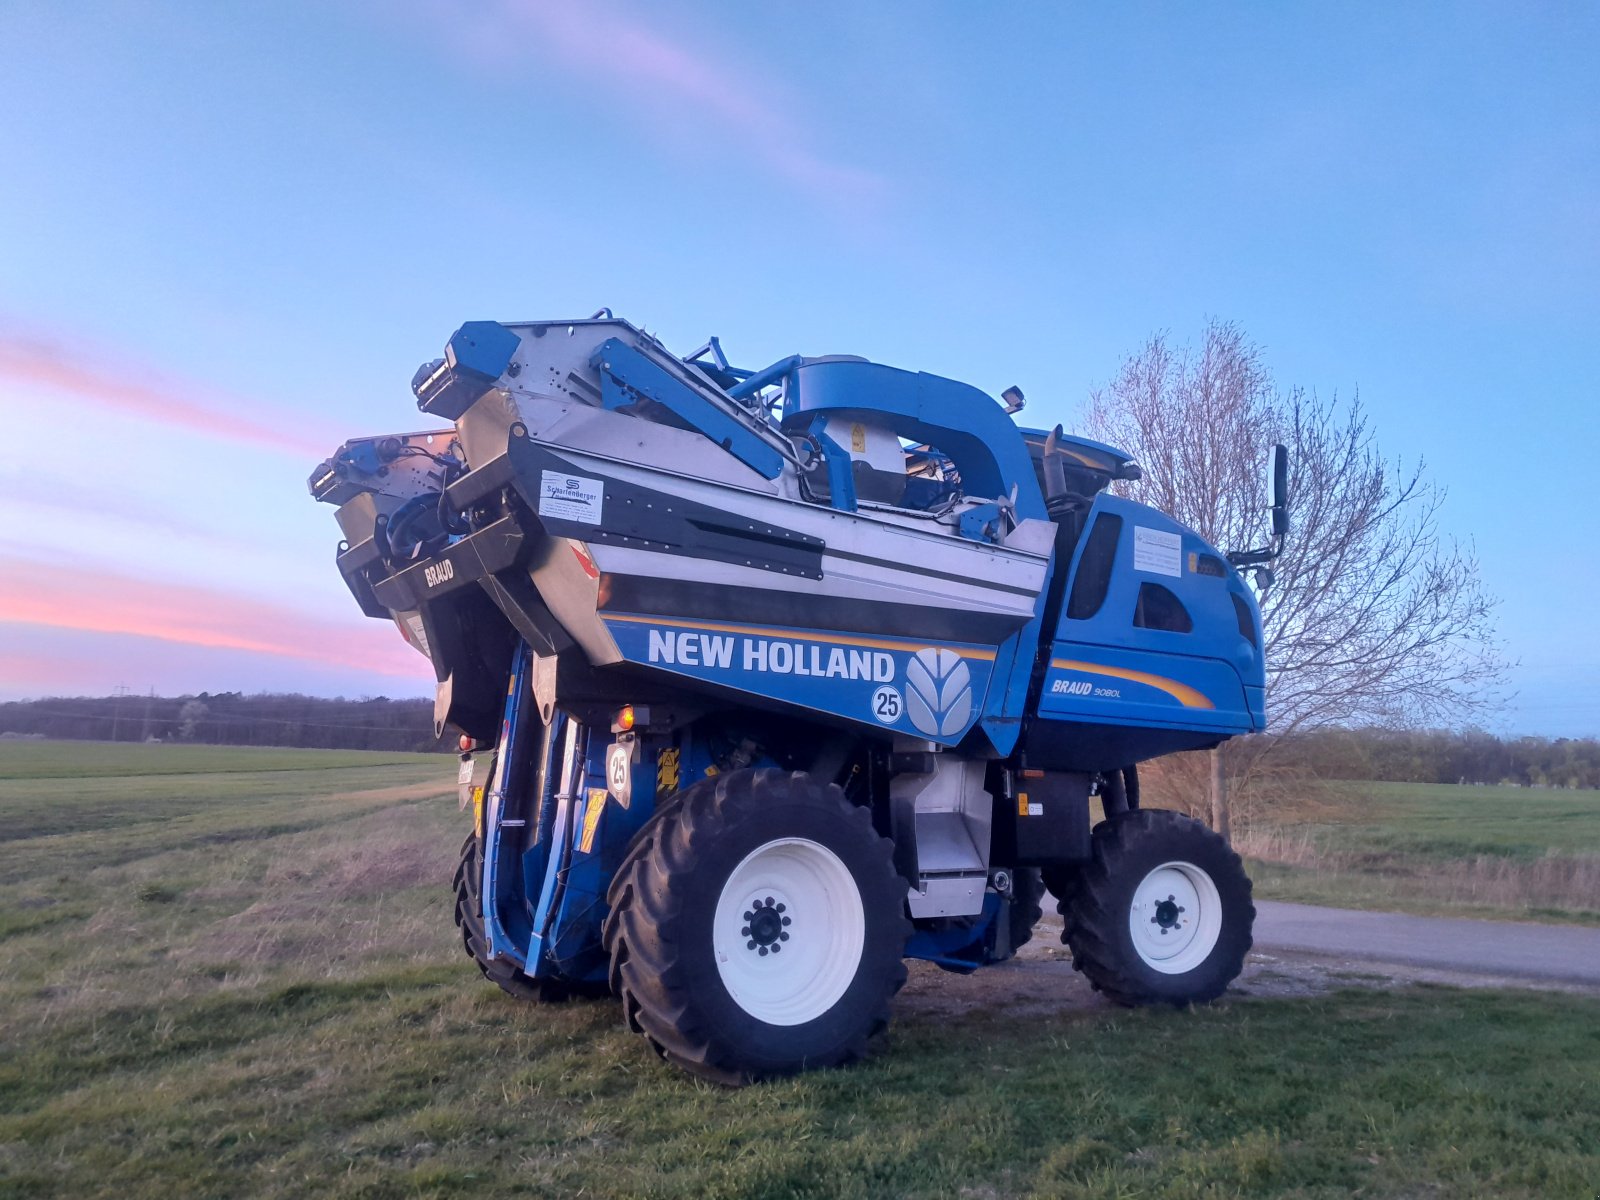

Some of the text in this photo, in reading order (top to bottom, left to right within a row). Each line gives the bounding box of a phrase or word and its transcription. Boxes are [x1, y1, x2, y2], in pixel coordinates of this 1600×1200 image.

[424, 559, 454, 588] BRAUD
[648, 629, 896, 683] NEW HOLLAND
[1051, 679, 1121, 698] BRAUD 9080L
[876, 692, 899, 717] 25
[612, 756, 625, 785] 25
